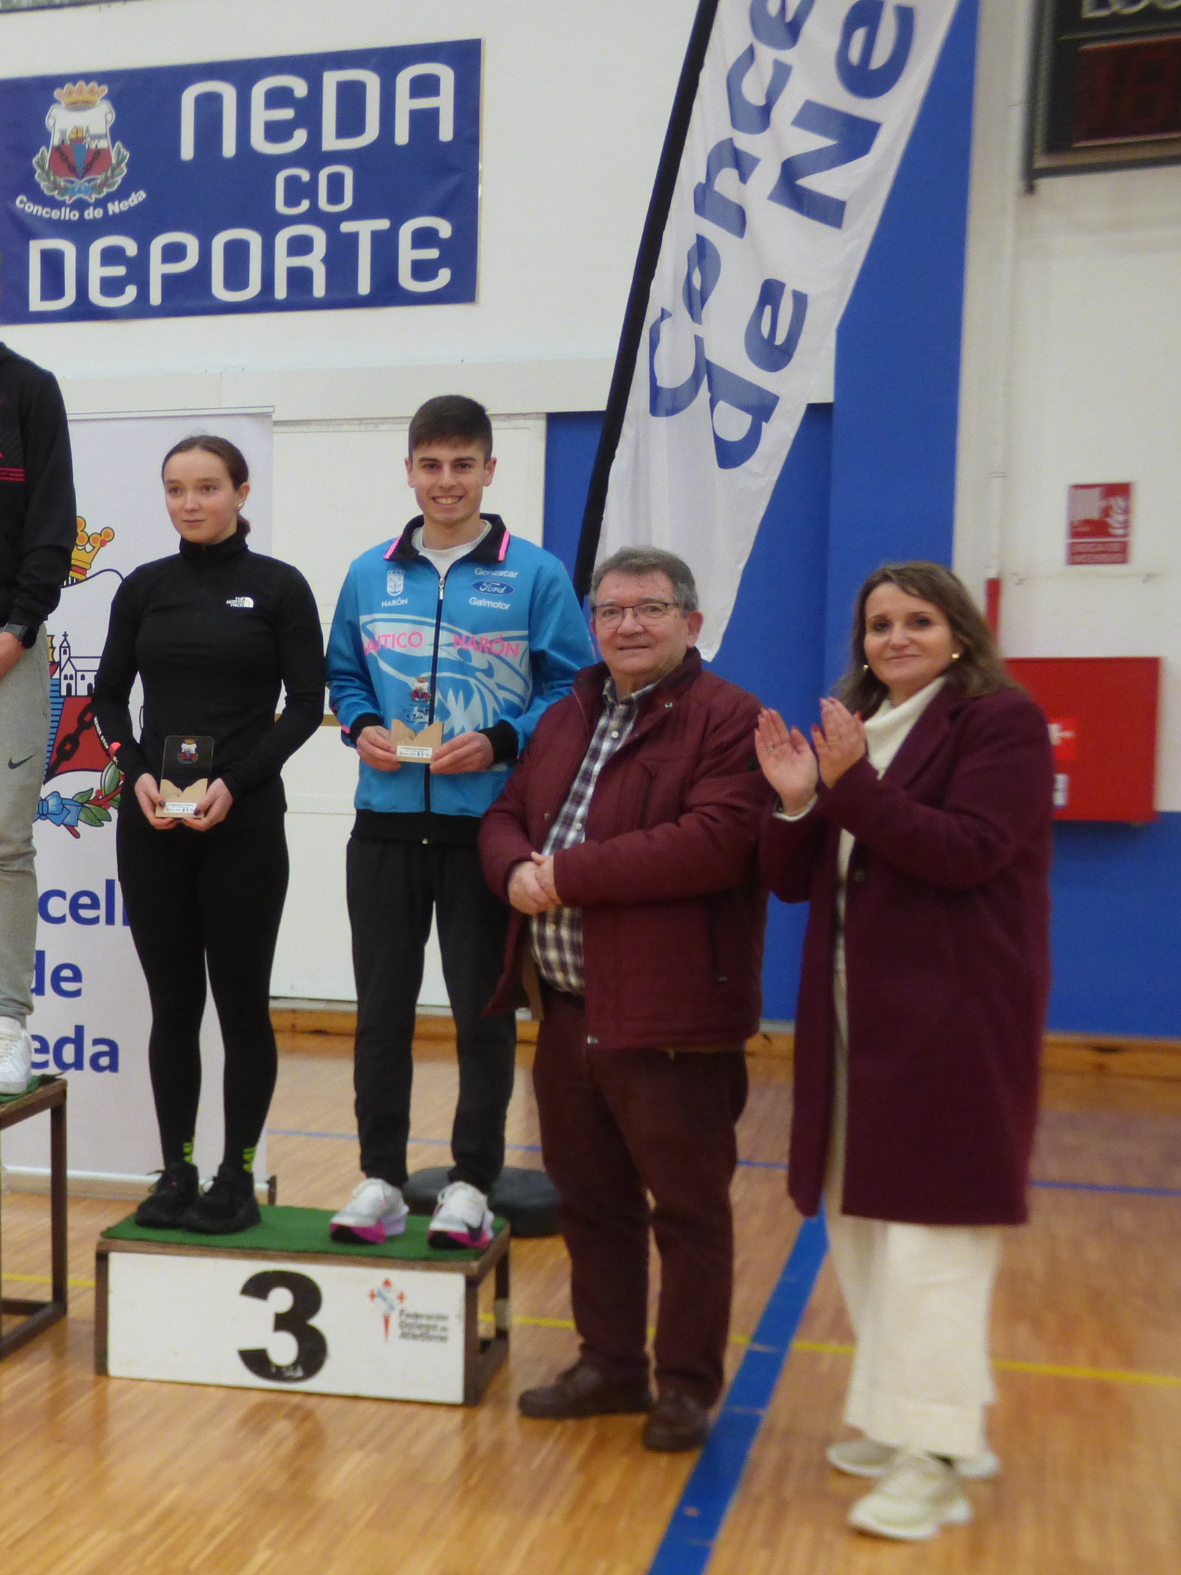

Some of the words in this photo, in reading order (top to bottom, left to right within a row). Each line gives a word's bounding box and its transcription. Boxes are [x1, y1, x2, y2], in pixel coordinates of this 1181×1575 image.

[179, 61, 456, 162] NEDA
[15, 194, 80, 221] Concello
[83, 205, 104, 220] de
[106, 189, 148, 216] Neda
[274, 164, 354, 216] CO
[28, 215, 453, 312] DEPORTE
[705, 278, 809, 470] de
[474, 567, 519, 578] Gonzacar
[479, 581, 507, 594] Ford
[381, 597, 408, 608] NARÓN
[469, 596, 511, 611] Galmotor
[452, 632, 521, 659] NARÓN
[237, 1269, 329, 1384] 3
